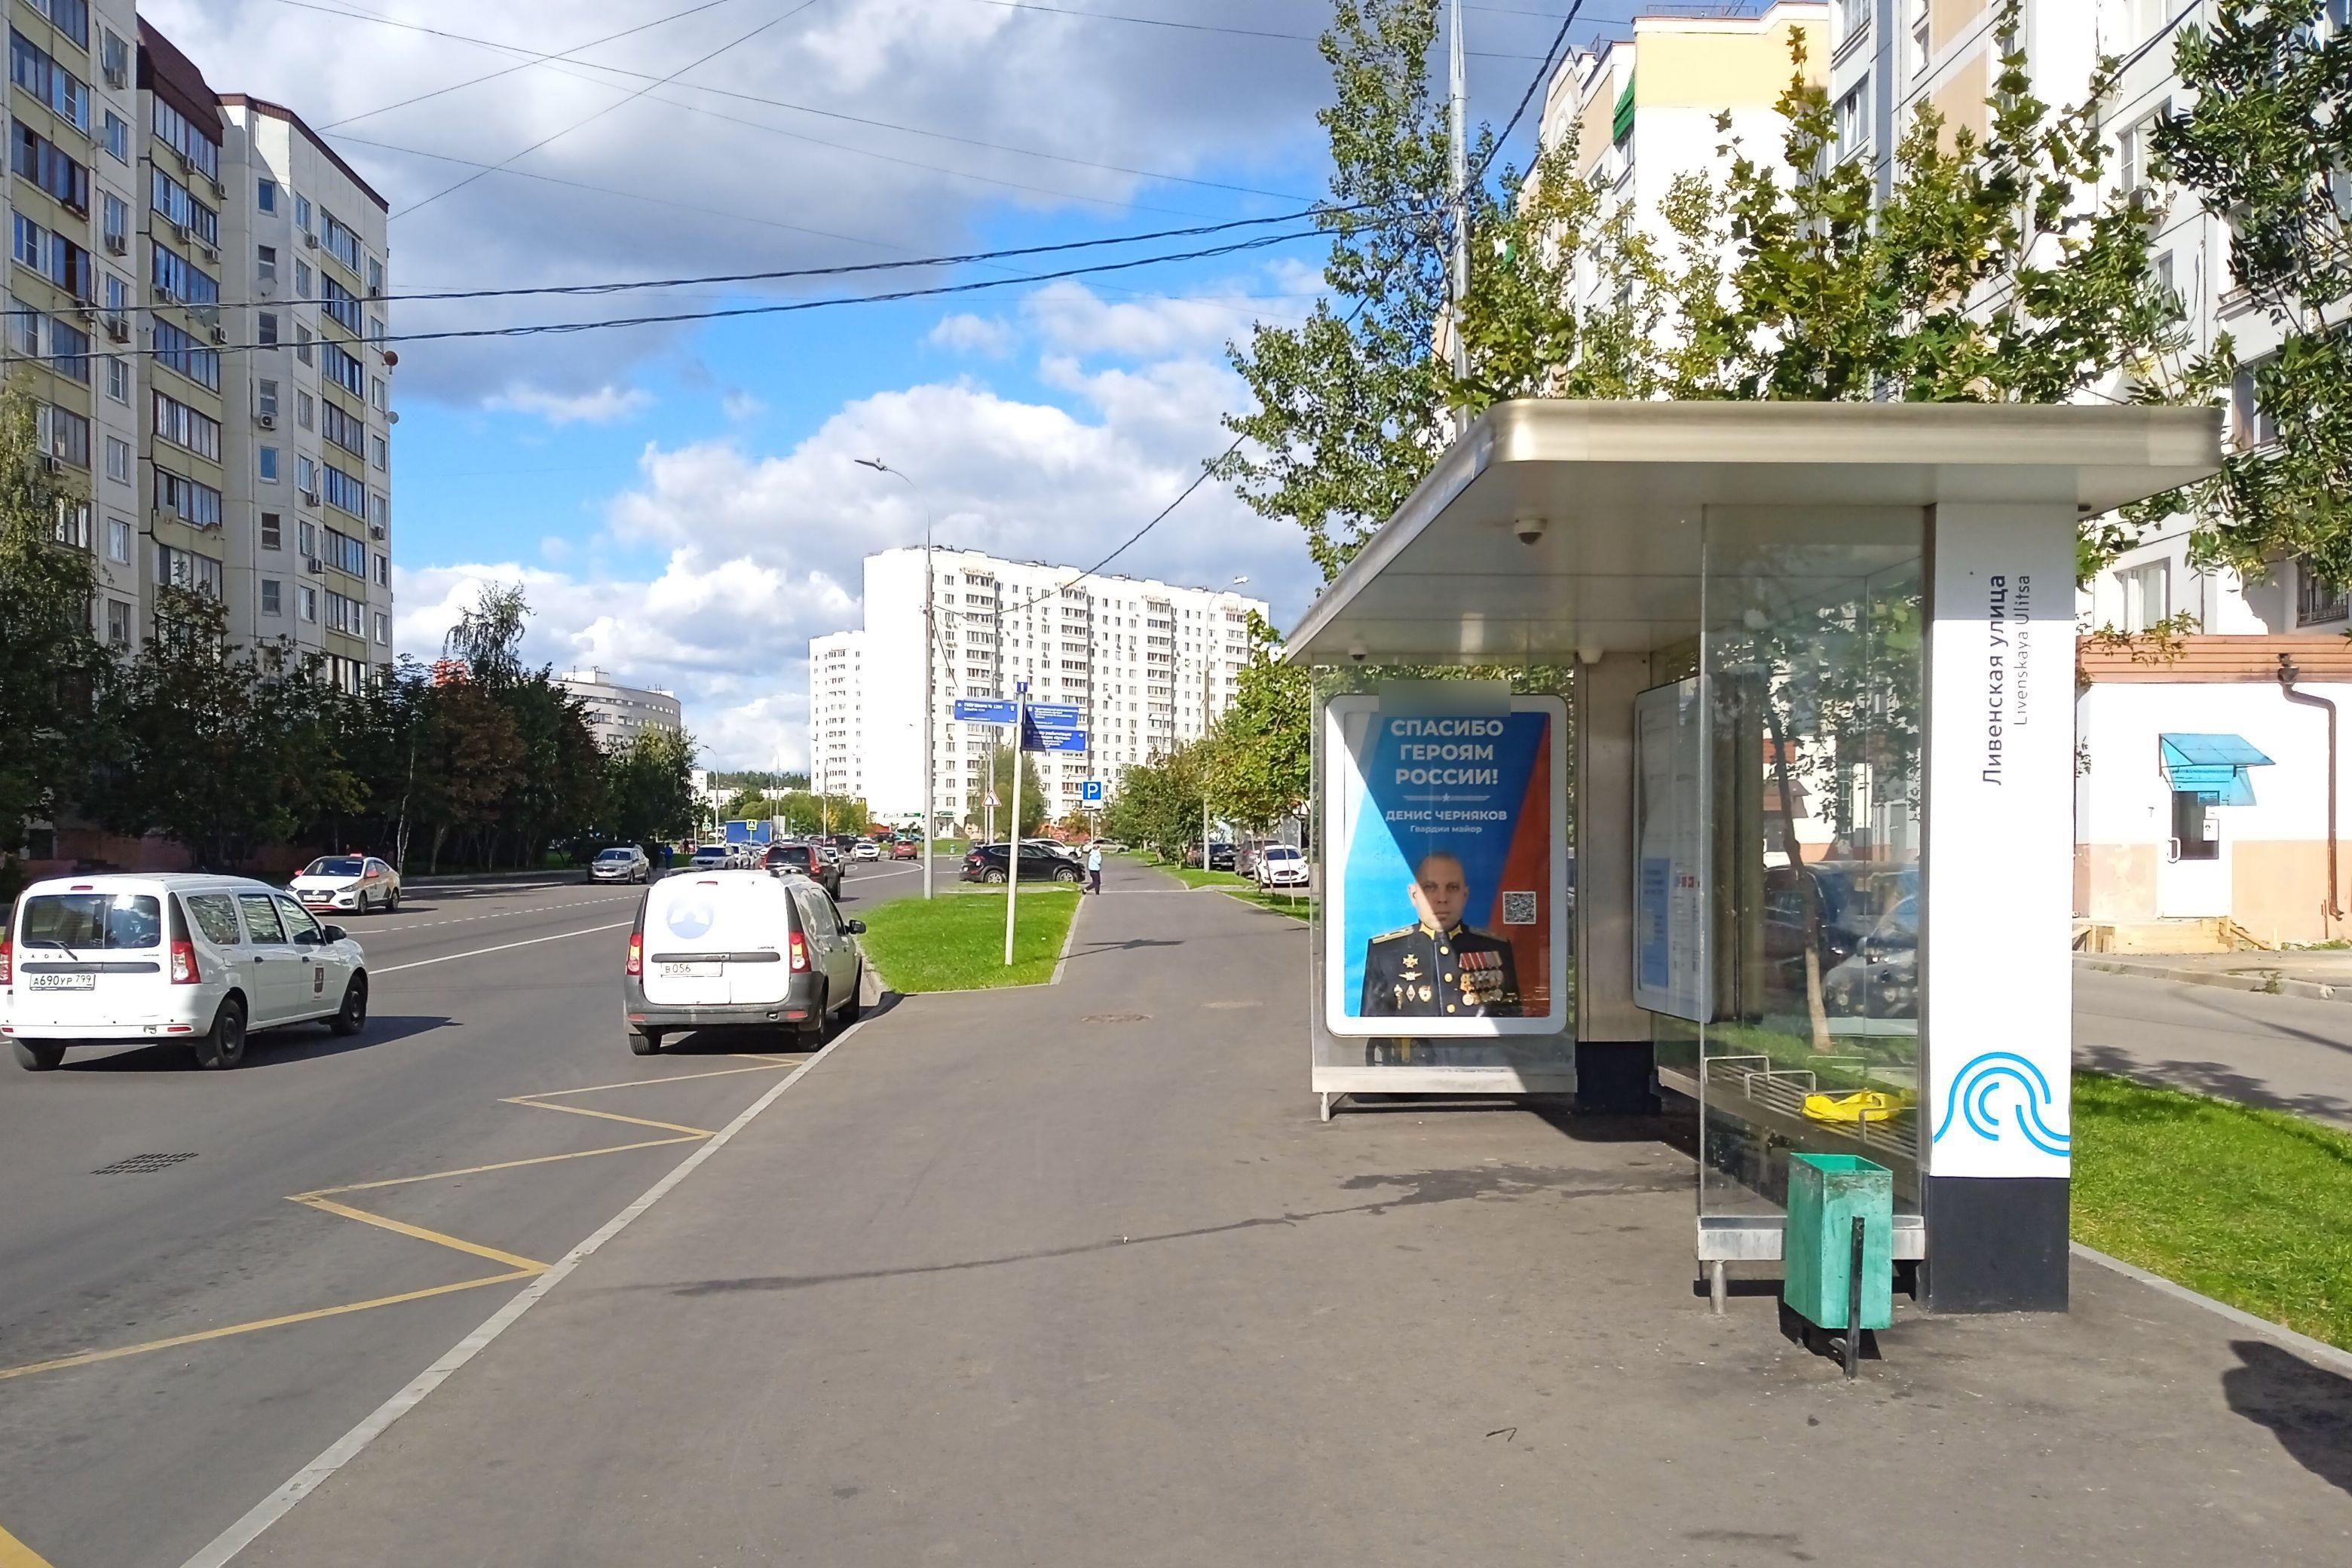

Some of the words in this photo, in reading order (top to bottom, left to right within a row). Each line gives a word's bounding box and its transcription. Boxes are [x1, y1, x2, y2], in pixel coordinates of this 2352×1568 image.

[2013, 575, 2030, 624] Ulitsa
[1990, 575, 2008, 647] улица
[2014, 632, 2031, 725] Livenskaya
[1391, 719, 1504, 737] СПАСИБО
[1983, 656, 2004, 786] Ливенская
[1400, 744, 1493, 761] ГЕРОЯМ
[1395, 768, 1499, 785] РОССИИ!
[1386, 810, 1432, 822] ДЕНИС
[1435, 810, 1508, 821] ЧЕРНЯКОВ
[1410, 825, 1450, 834] Гвардии
[1452, 825, 1484, 835] майор
